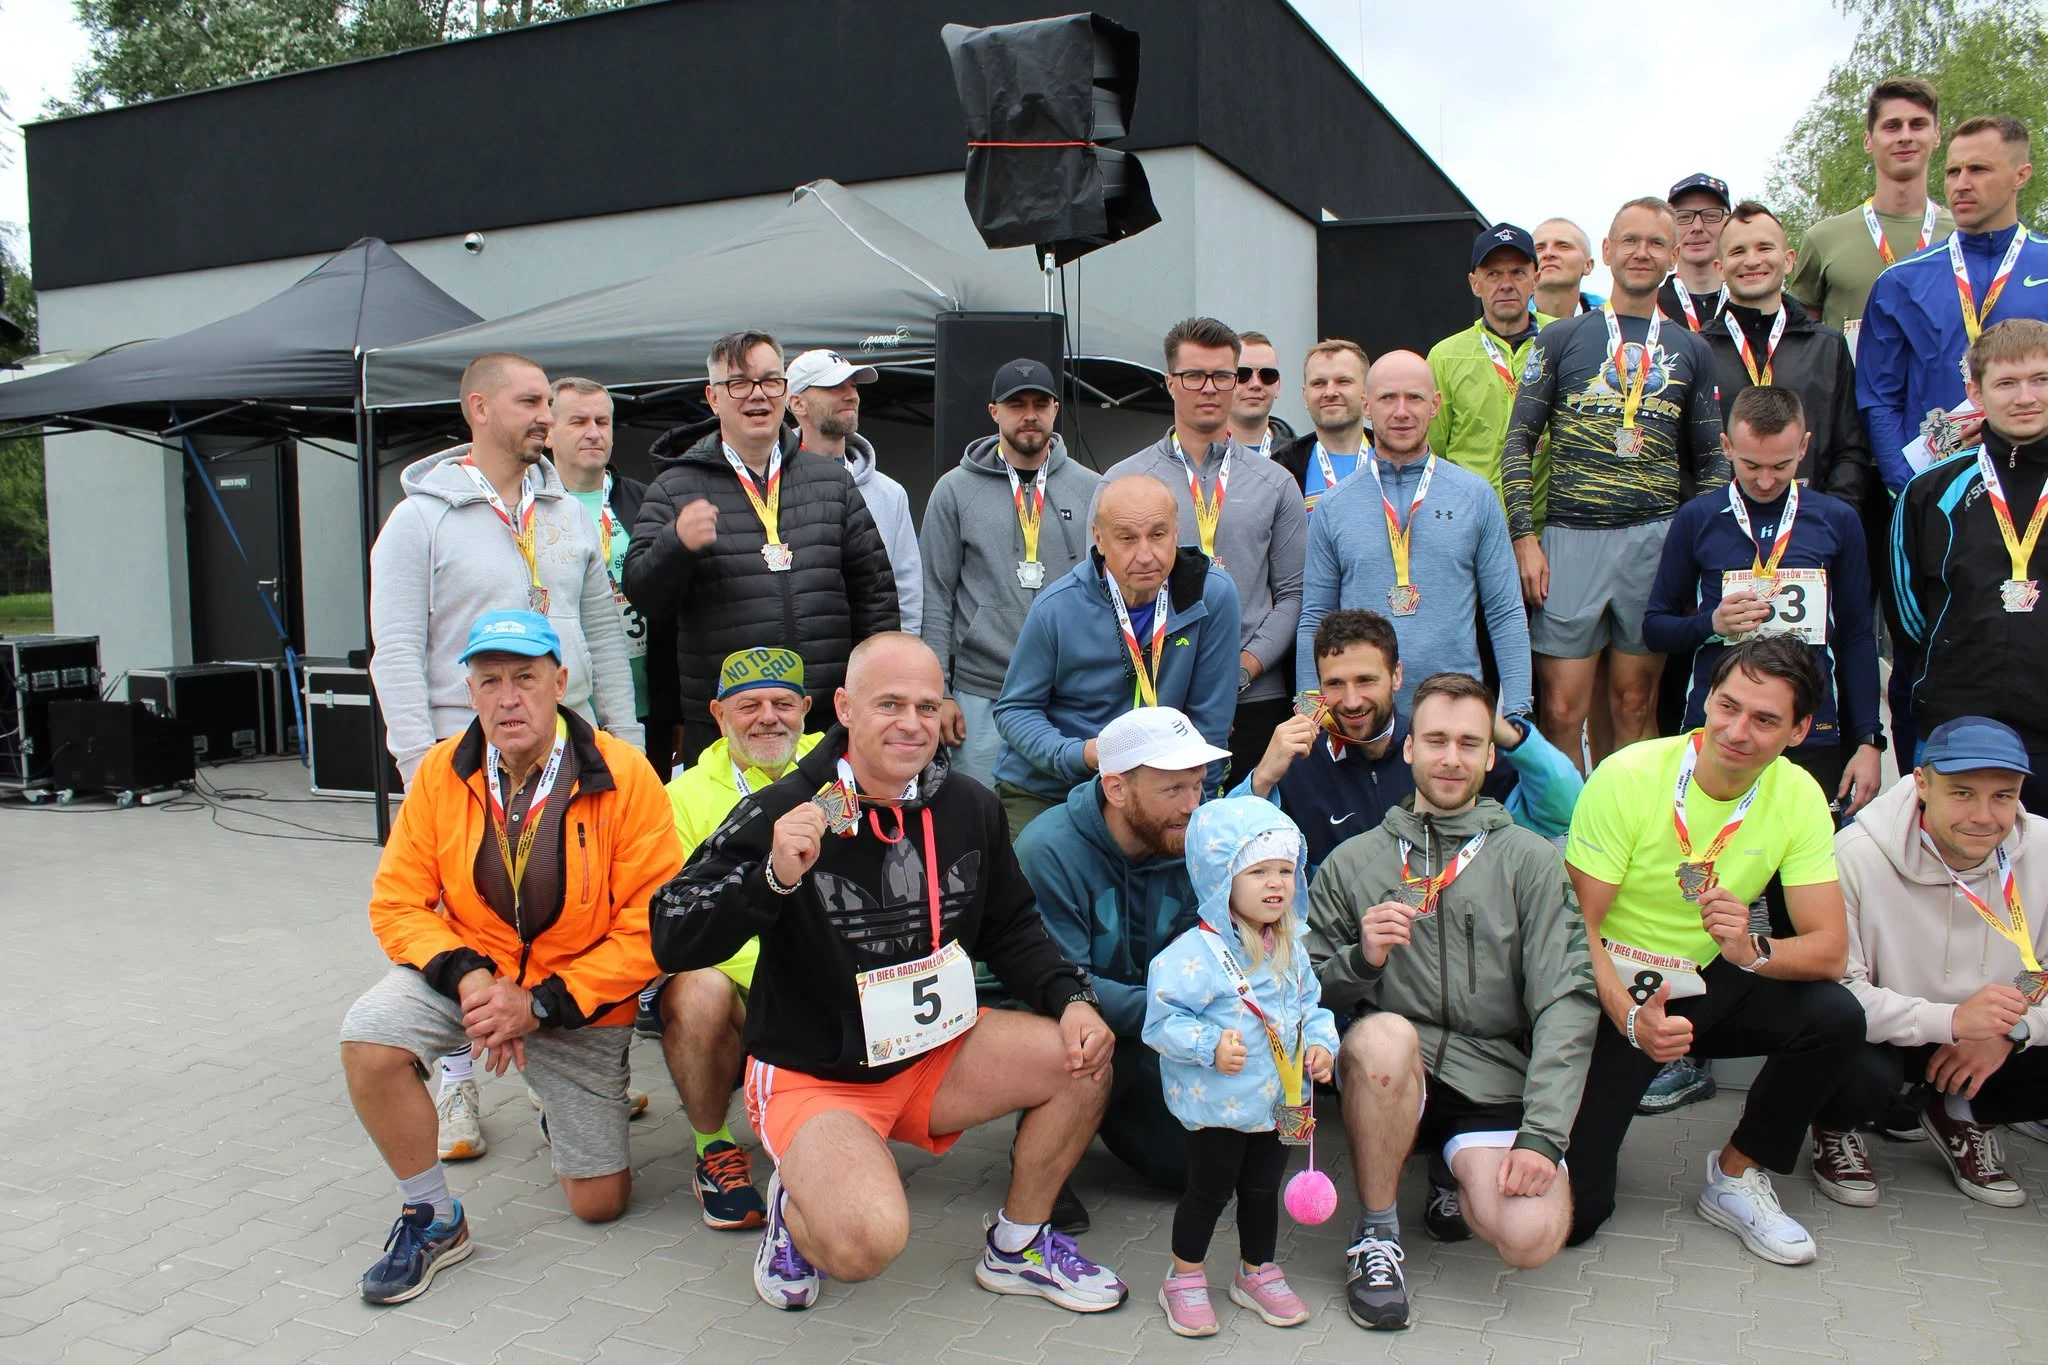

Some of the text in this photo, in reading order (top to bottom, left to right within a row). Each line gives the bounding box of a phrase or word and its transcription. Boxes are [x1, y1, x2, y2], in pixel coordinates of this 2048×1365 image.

[866, 335, 900, 344] GARDEN
[1738, 571, 1752, 580] BIEG
[724, 650, 771, 683] NO TO
[760, 651, 796, 681] SRU
[869, 973, 875, 983] II
[877, 969, 895, 982] BIEG
[897, 953, 945, 977] RADZIWIŁŁÓW
[1607, 942, 1613, 951] II
[1614, 944, 1630, 956] BIEG
[1632, 949, 1680, 968] RADZIWIŁŁÓW
[913, 974, 942, 1025] 5
[1627, 970, 1664, 1006] 8
